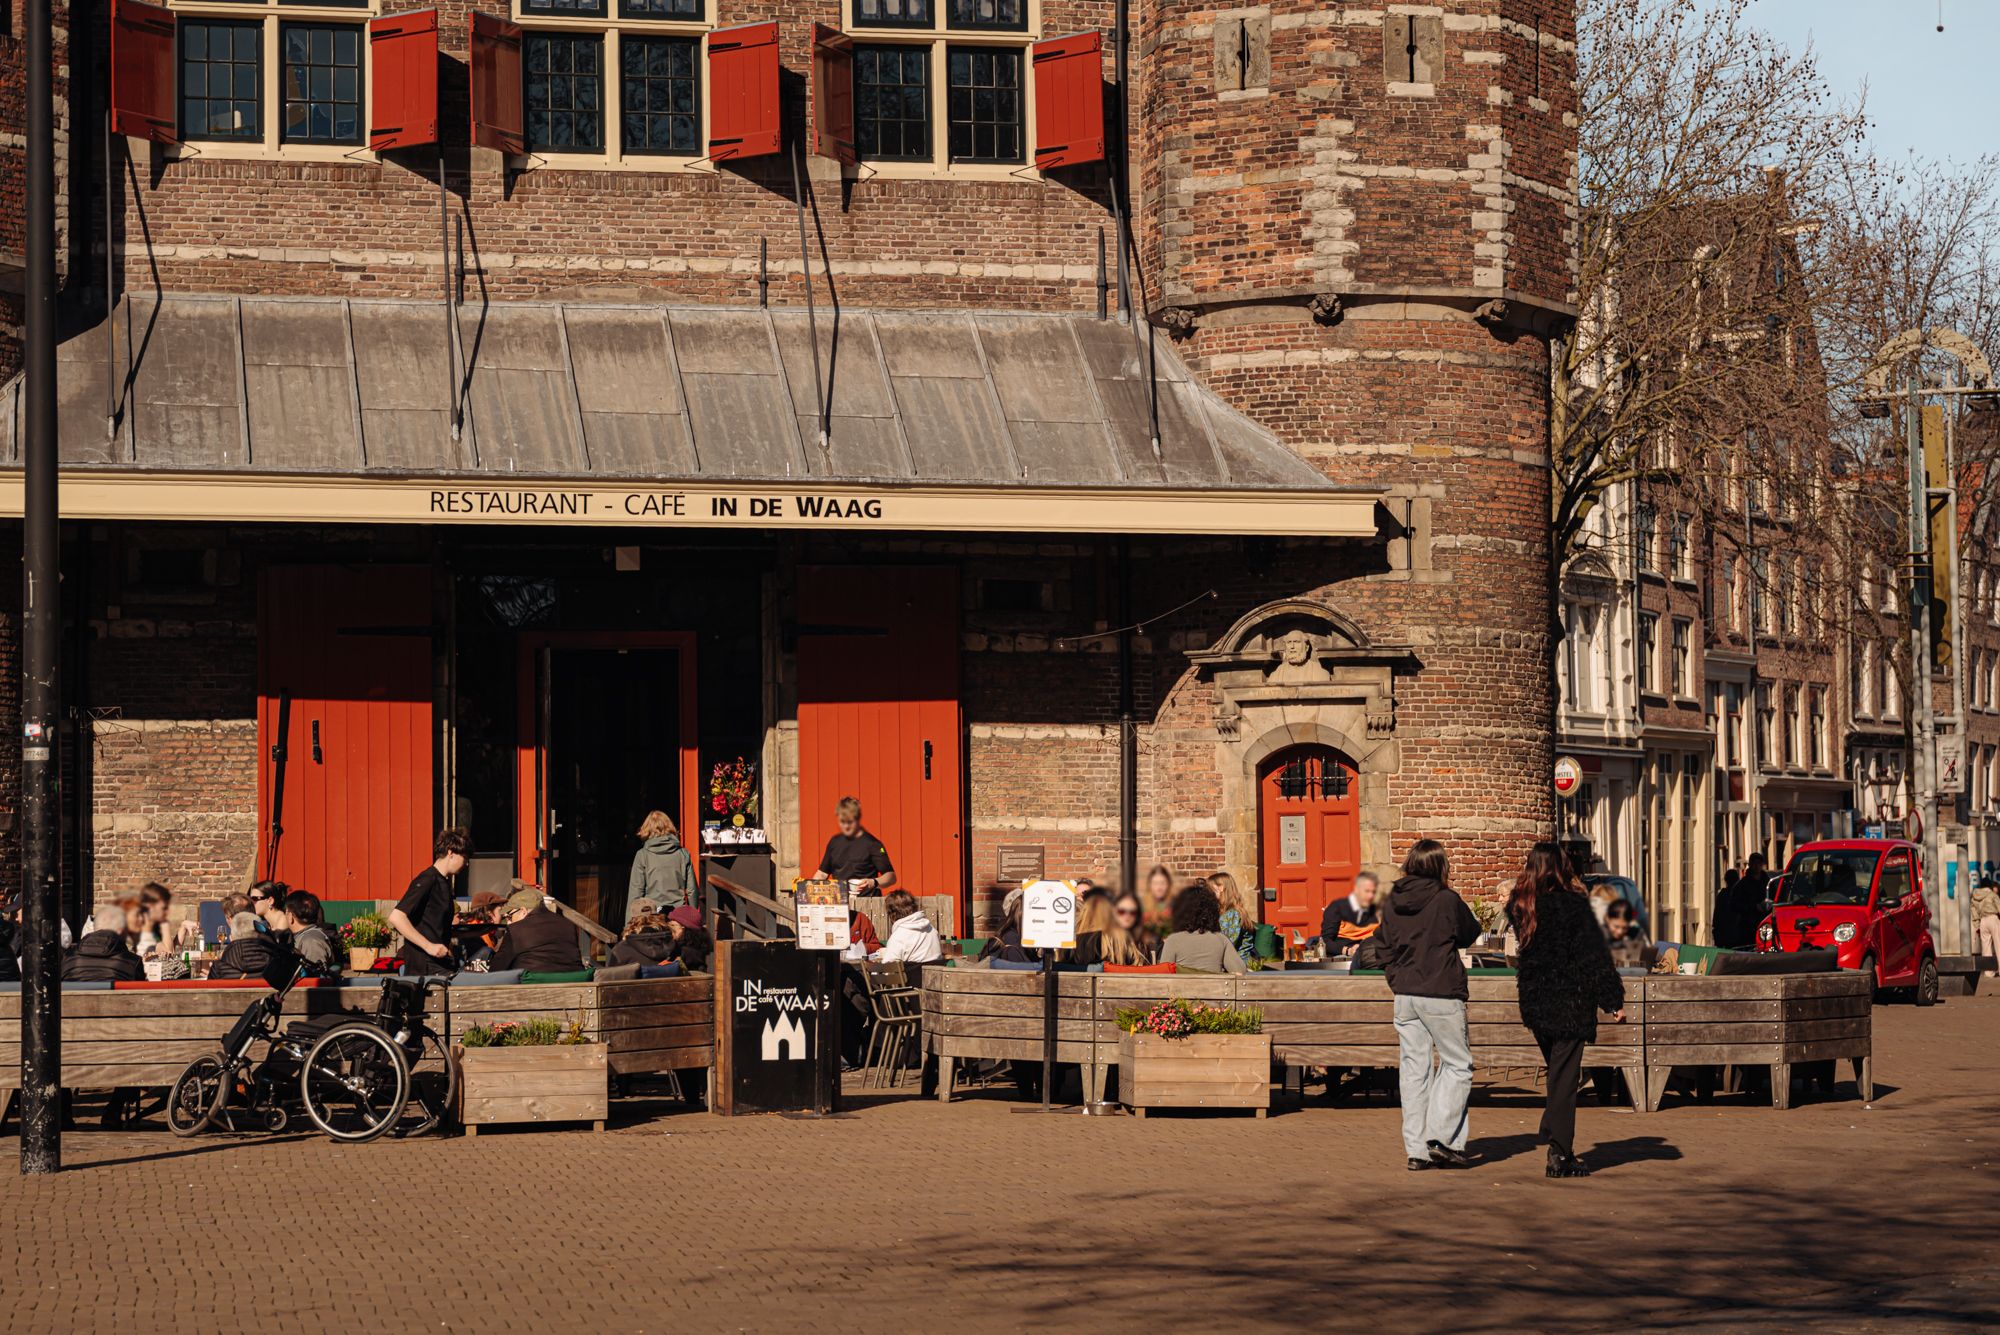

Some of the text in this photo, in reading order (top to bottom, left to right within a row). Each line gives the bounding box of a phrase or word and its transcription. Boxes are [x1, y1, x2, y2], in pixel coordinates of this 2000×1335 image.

[431, 491, 593, 514] RESTAURANT
[624, 491, 685, 516] CAFÉ
[711, 497, 737, 516] IN
[749, 498, 782, 517] DE
[795, 496, 882, 518] WAAG
[743, 979, 762, 996] IN
[763, 987, 798, 995] restaurant
[736, 996, 757, 1012] DE
[758, 993, 774, 1003] café
